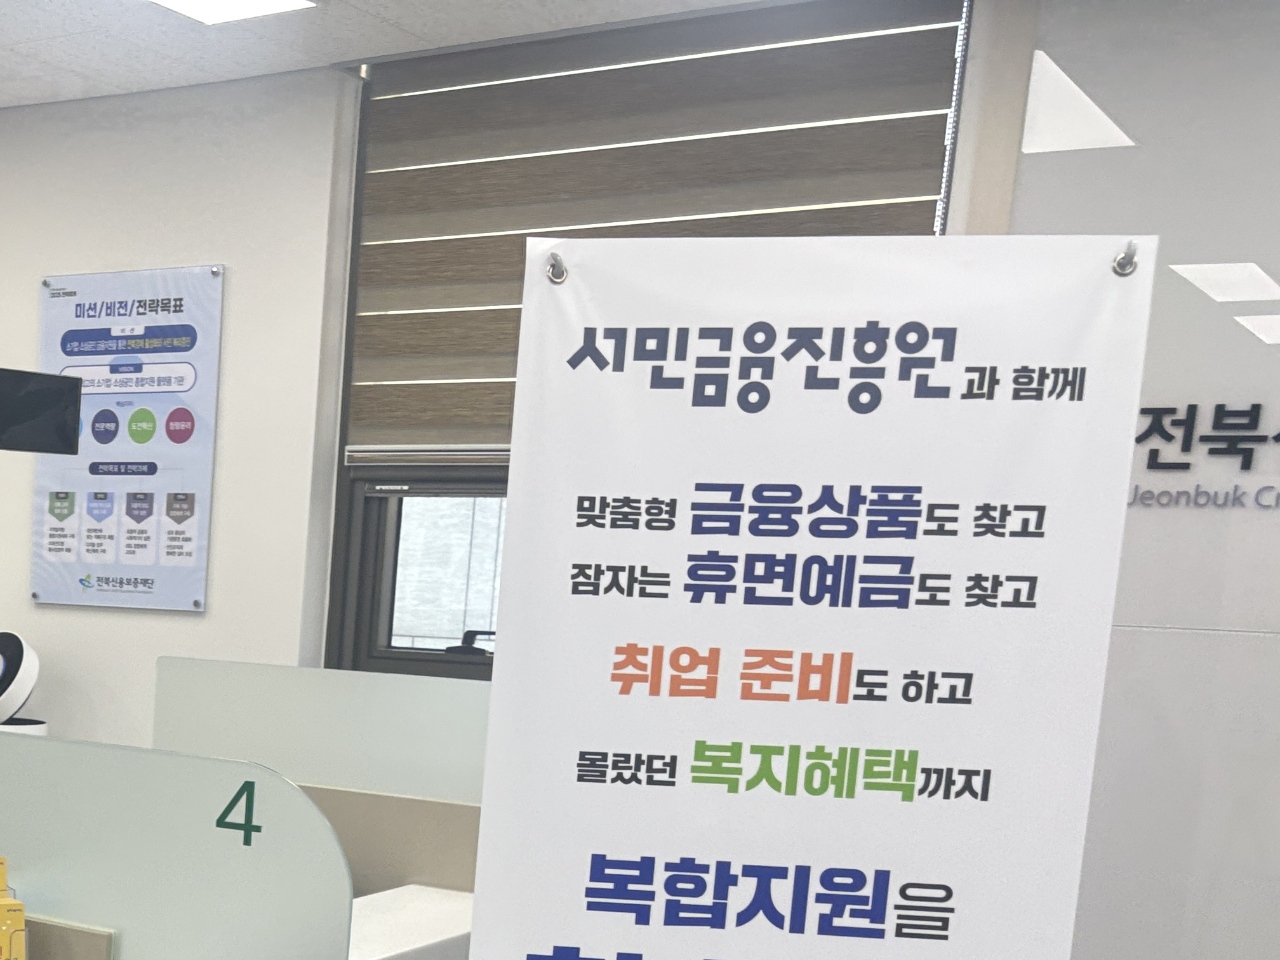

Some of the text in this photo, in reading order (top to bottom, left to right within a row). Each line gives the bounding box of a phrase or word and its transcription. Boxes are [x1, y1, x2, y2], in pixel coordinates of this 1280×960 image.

[1012, 366, 1087, 402] 함께
[1135, 403, 1280, 470] 전북
[575, 482, 1048, 540] 맞춤형 금융상품도 찾고
[1127, 484, 1248, 509] Jeonbuk
[570, 550, 1039, 610] 잠자는 휴면예금도 찾고
[610, 642, 974, 705] 취업 준비도 하고
[576, 740, 992, 803] 몰랐던 복지혜택까지
[216, 781, 262, 846] 4
[585, 853, 955, 941] 복합지원을
